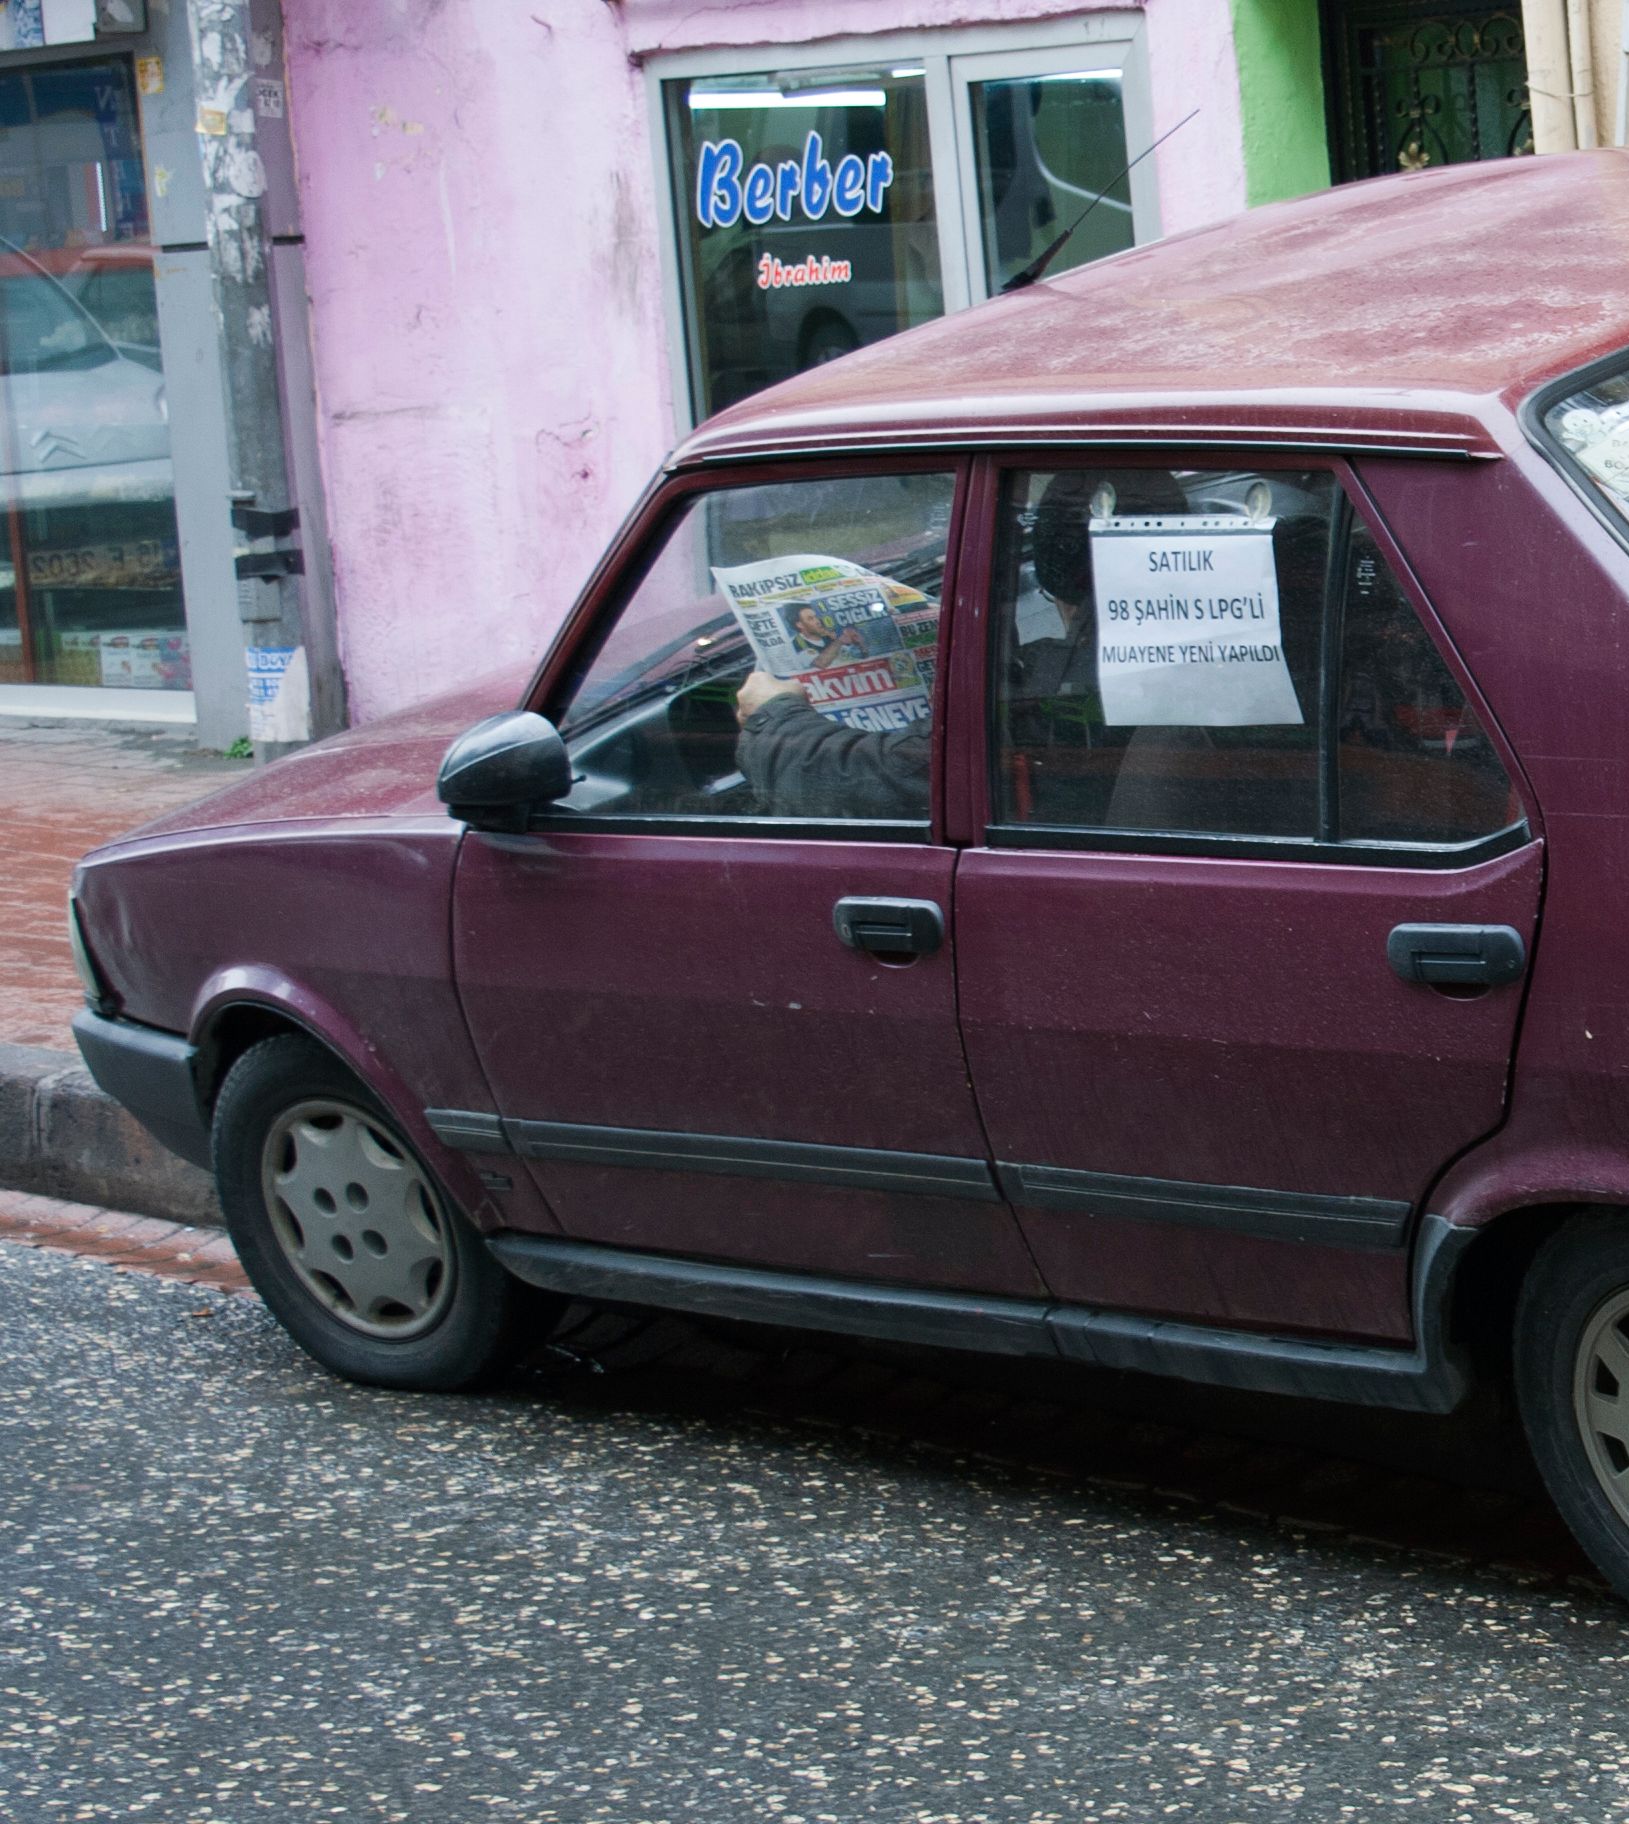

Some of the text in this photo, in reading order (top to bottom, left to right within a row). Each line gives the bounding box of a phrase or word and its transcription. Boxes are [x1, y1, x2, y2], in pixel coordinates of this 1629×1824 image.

[697, 130, 893, 228] Berber
[1148, 549, 1214, 573] SATILIK
[1107, 599, 1130, 621] 98
[1134, 593, 1190, 626] ŞAHİN
[1194, 598, 1205, 620] S
[1101, 640, 1281, 664] MUAYENE YENİ YAPILDI
